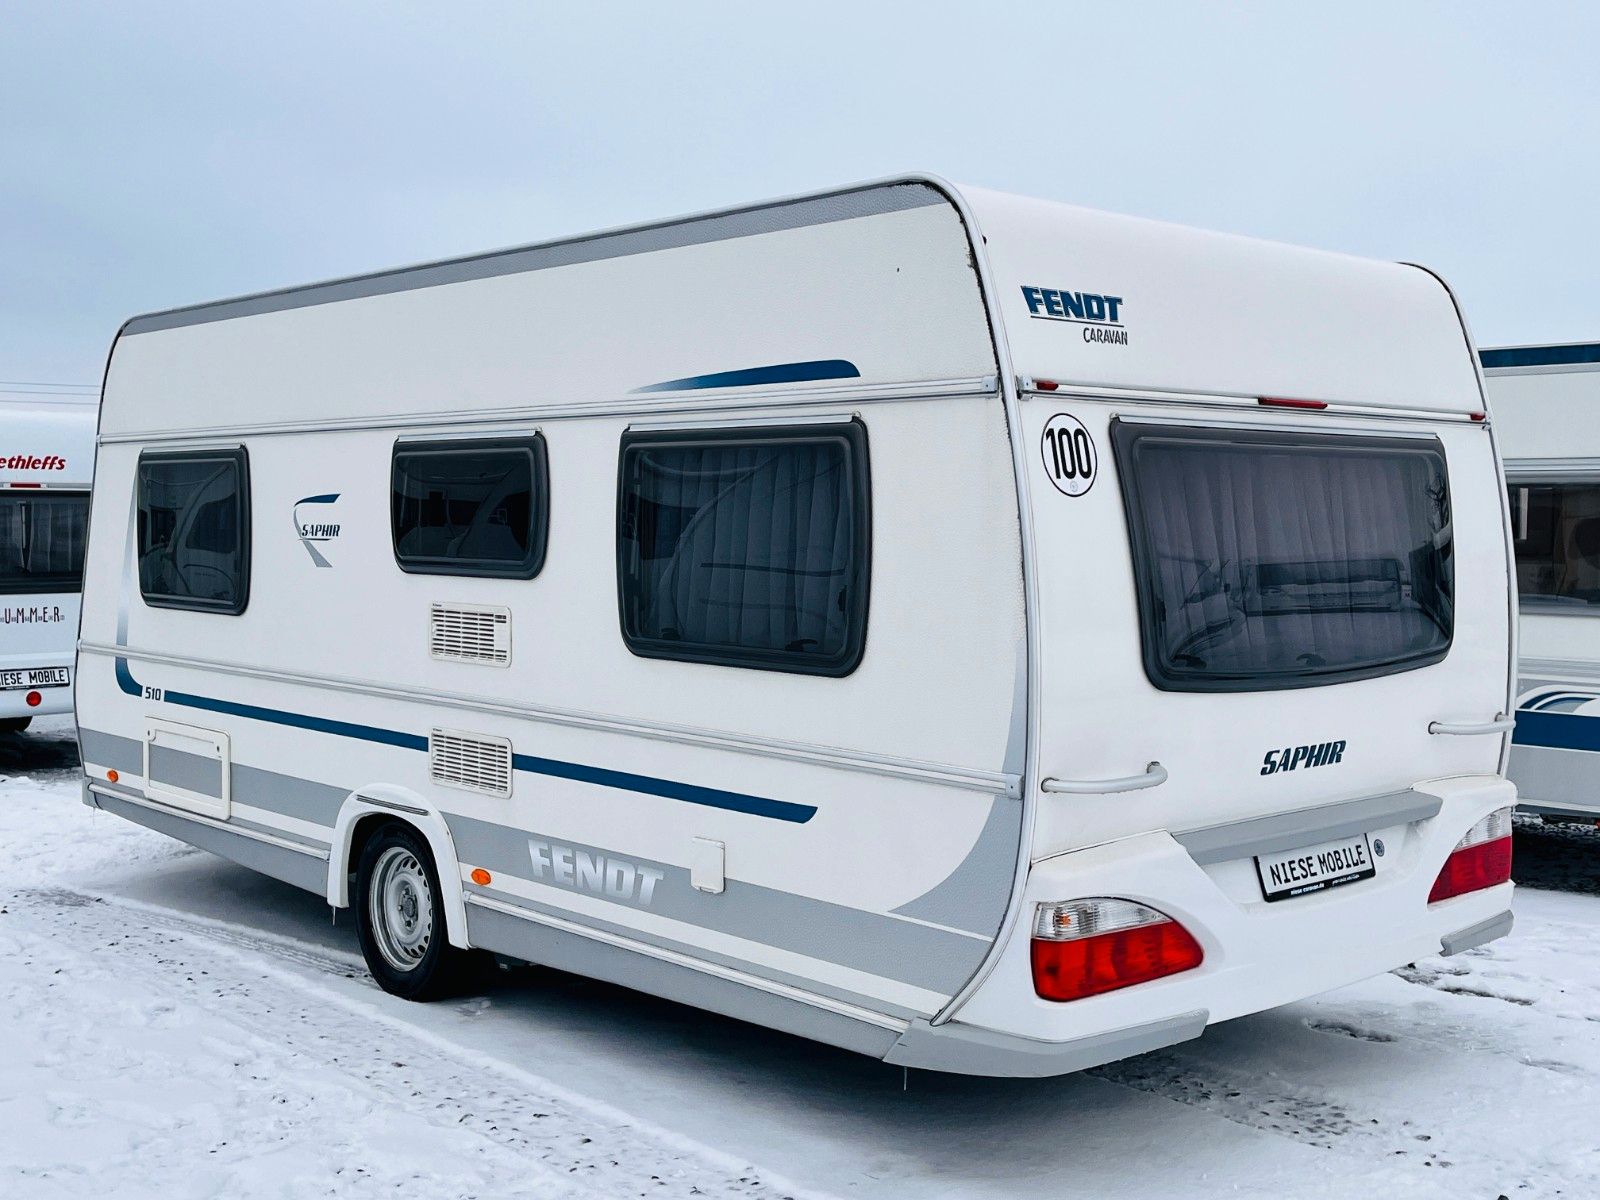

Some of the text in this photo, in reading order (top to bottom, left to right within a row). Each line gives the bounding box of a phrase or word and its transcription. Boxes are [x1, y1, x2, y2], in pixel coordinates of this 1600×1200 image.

[1020, 285, 1123, 323] FENDT
[1083, 327, 1128, 346] CARAVAN
[1046, 427, 1092, 480] 100
[301, 524, 341, 537] SAPHIR
[0, 669, 66, 687] IESE MOBILE
[145, 686, 162, 701] 510
[1260, 740, 1347, 776] SAPHIR
[527, 839, 664, 904] FENDT
[1269, 856, 1318, 886] NIESE
[1317, 844, 1366, 875] MOBILE
